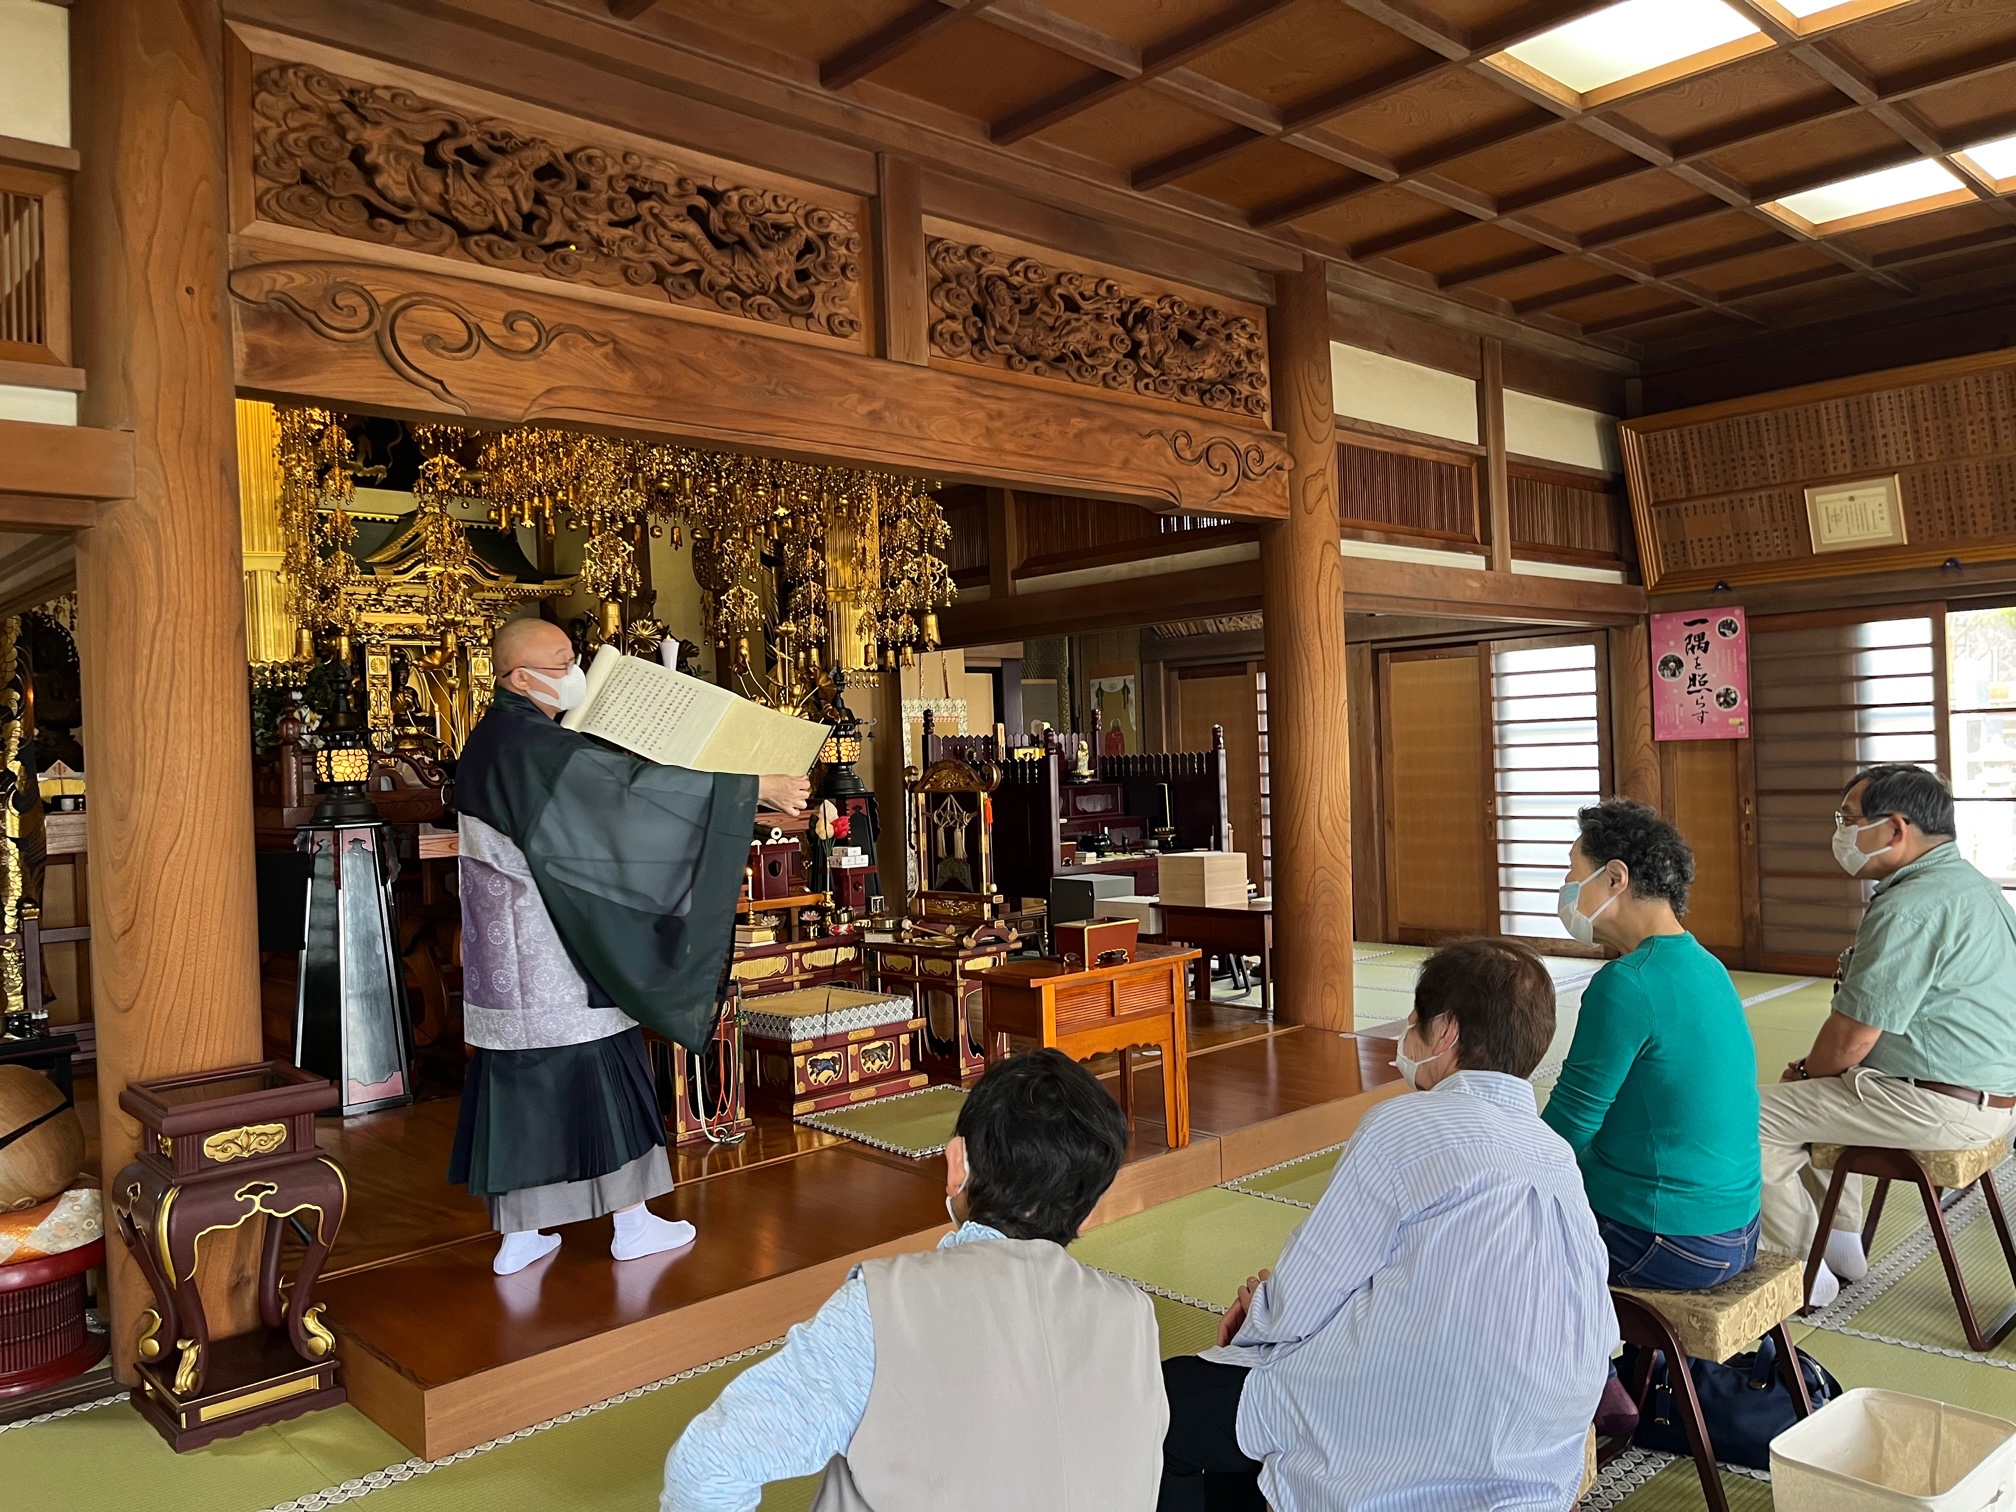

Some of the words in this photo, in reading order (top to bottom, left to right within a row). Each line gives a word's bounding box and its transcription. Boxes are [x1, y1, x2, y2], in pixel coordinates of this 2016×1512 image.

[1683, 618, 1713, 724] 一隅を照らす
